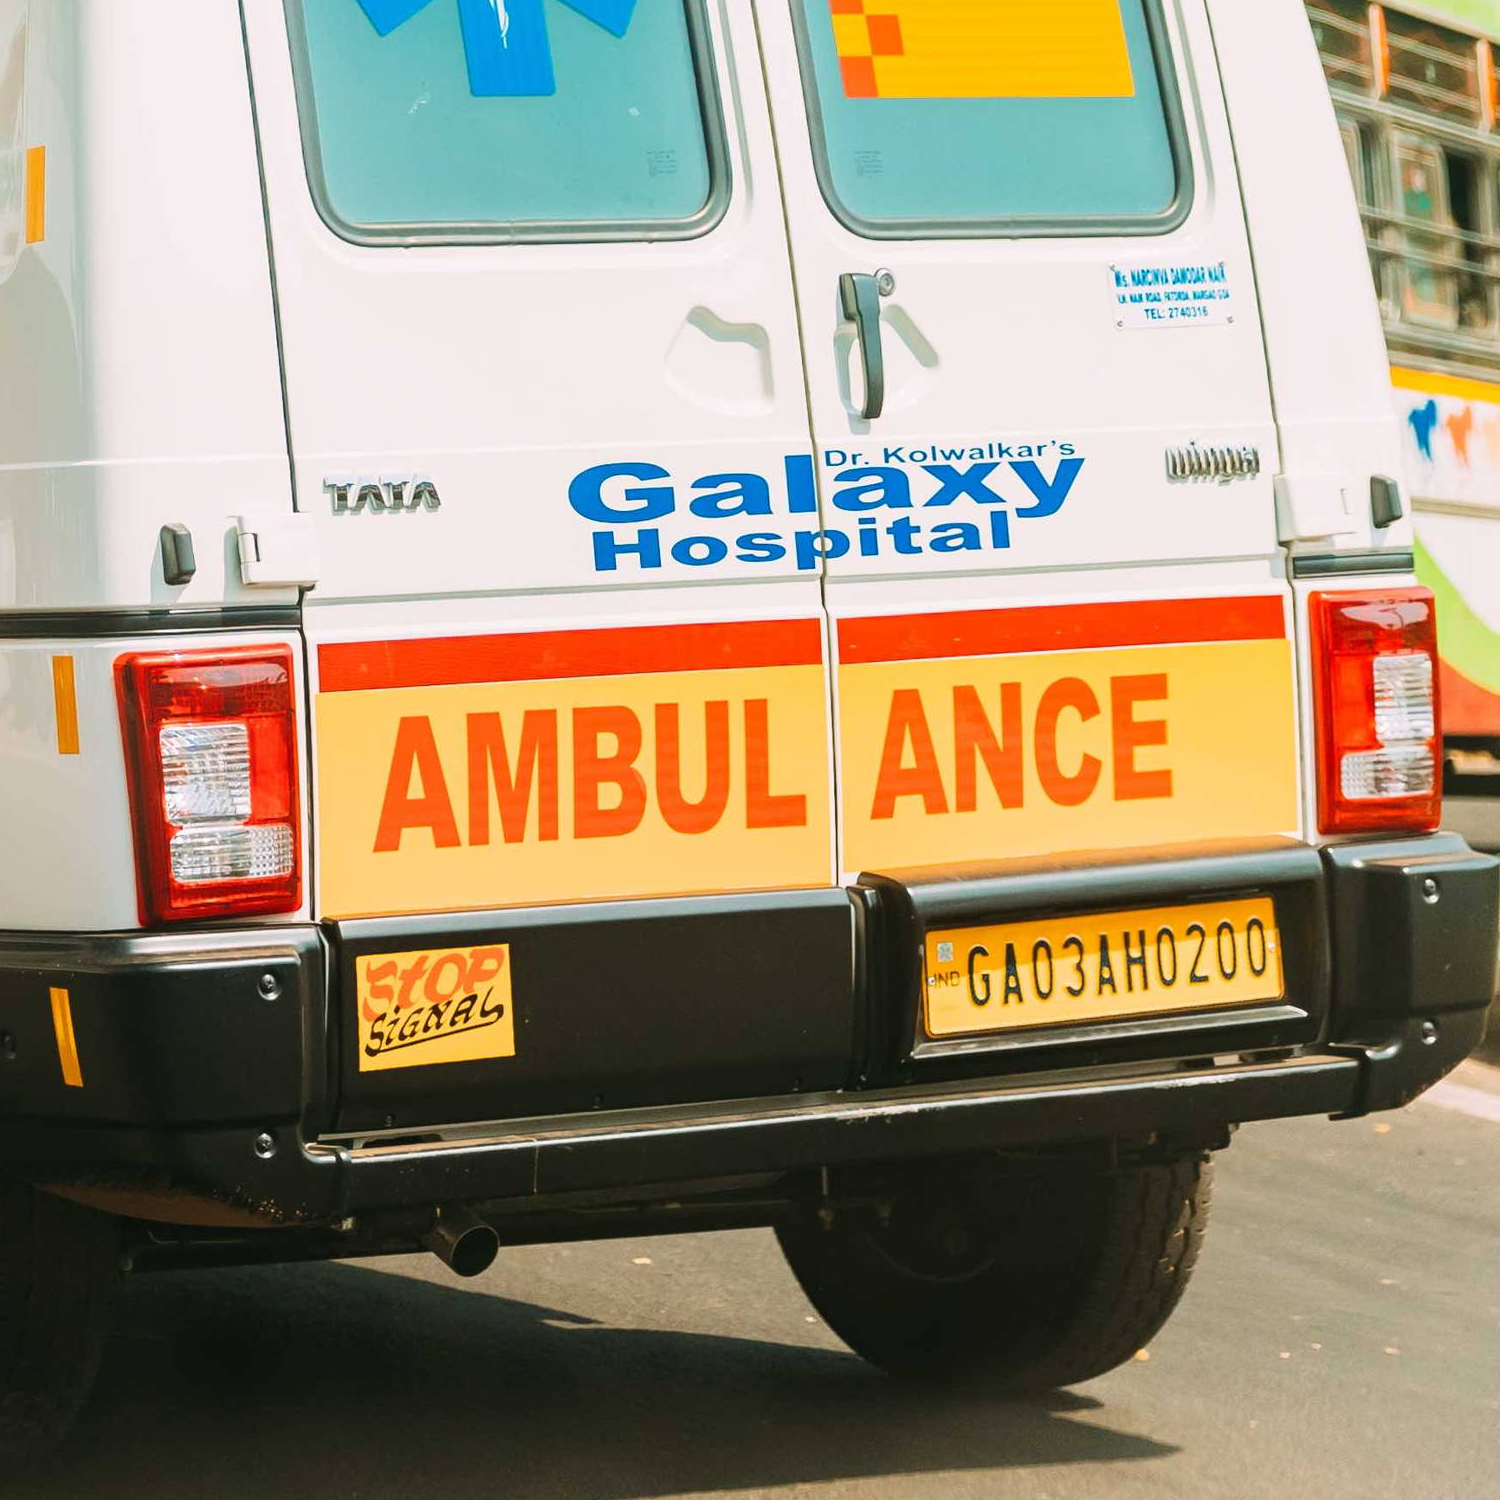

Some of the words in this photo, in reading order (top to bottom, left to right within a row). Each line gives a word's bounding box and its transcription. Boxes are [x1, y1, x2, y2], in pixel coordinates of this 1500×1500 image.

[825, 448, 869, 467] Dr.
[883, 439, 1076, 465] Kolwalkar's
[323, 474, 442, 513] TATA
[568, 454, 1086, 524] Galaxy
[592, 510, 1011, 572] Hospital
[966, 916, 1267, 1007] GA03AH0200
